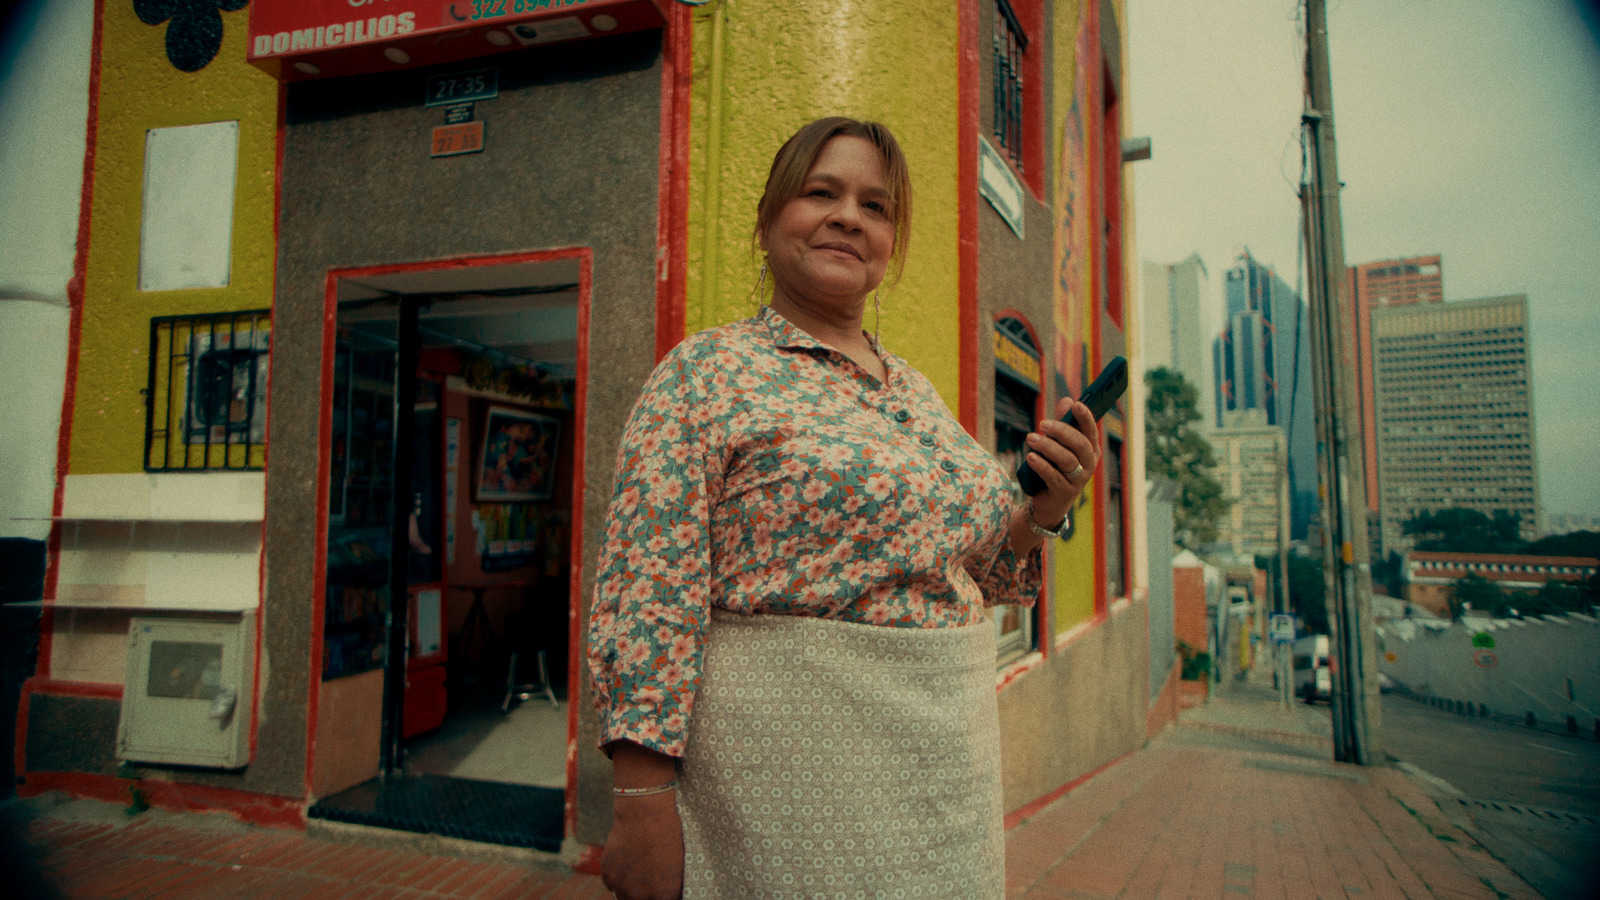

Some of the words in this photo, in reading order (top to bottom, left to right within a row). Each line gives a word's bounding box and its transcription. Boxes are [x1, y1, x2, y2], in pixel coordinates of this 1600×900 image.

[472, 0, 506, 20] 322
[254, 11, 416, 57] DOMICILIOS
[436, 75, 486, 99] 27-35
